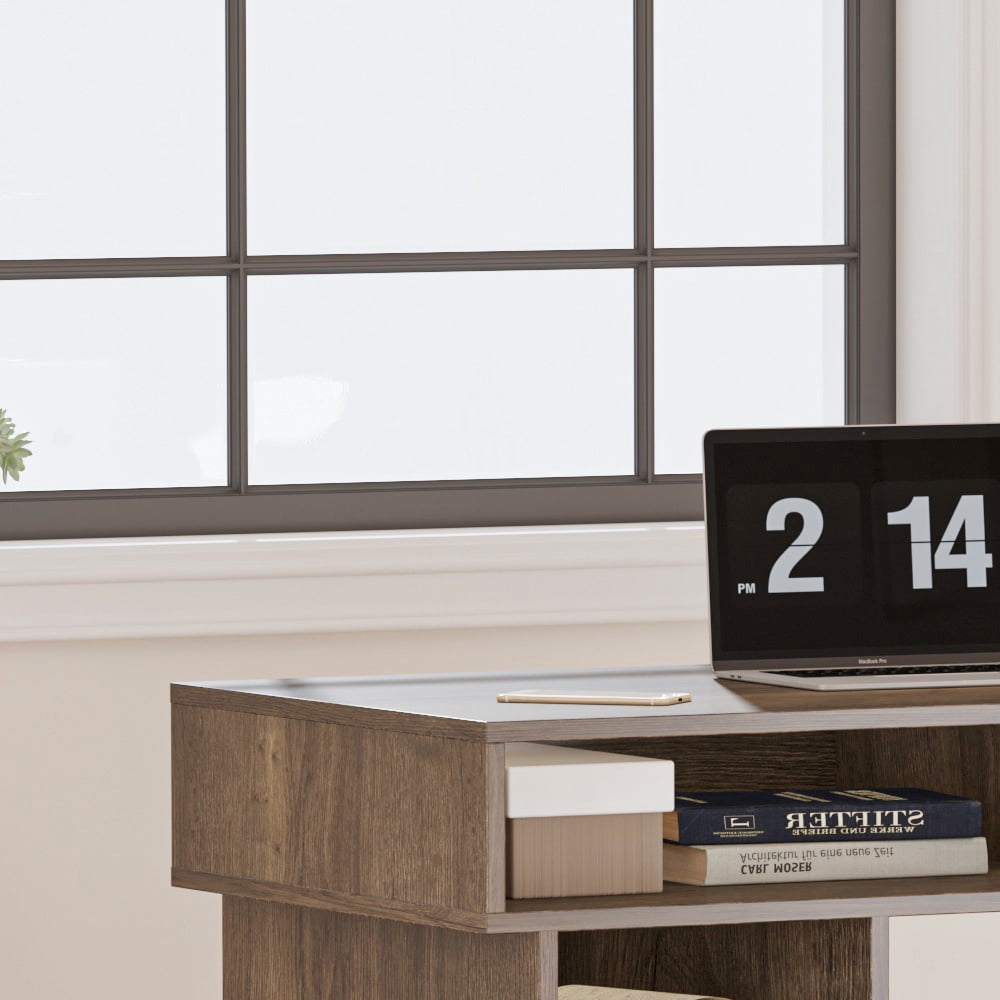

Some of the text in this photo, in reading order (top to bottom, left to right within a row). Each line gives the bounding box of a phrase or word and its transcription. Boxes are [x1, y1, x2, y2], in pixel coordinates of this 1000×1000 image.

[766, 494, 993, 593] 2 14
[737, 583, 756, 594] PM
